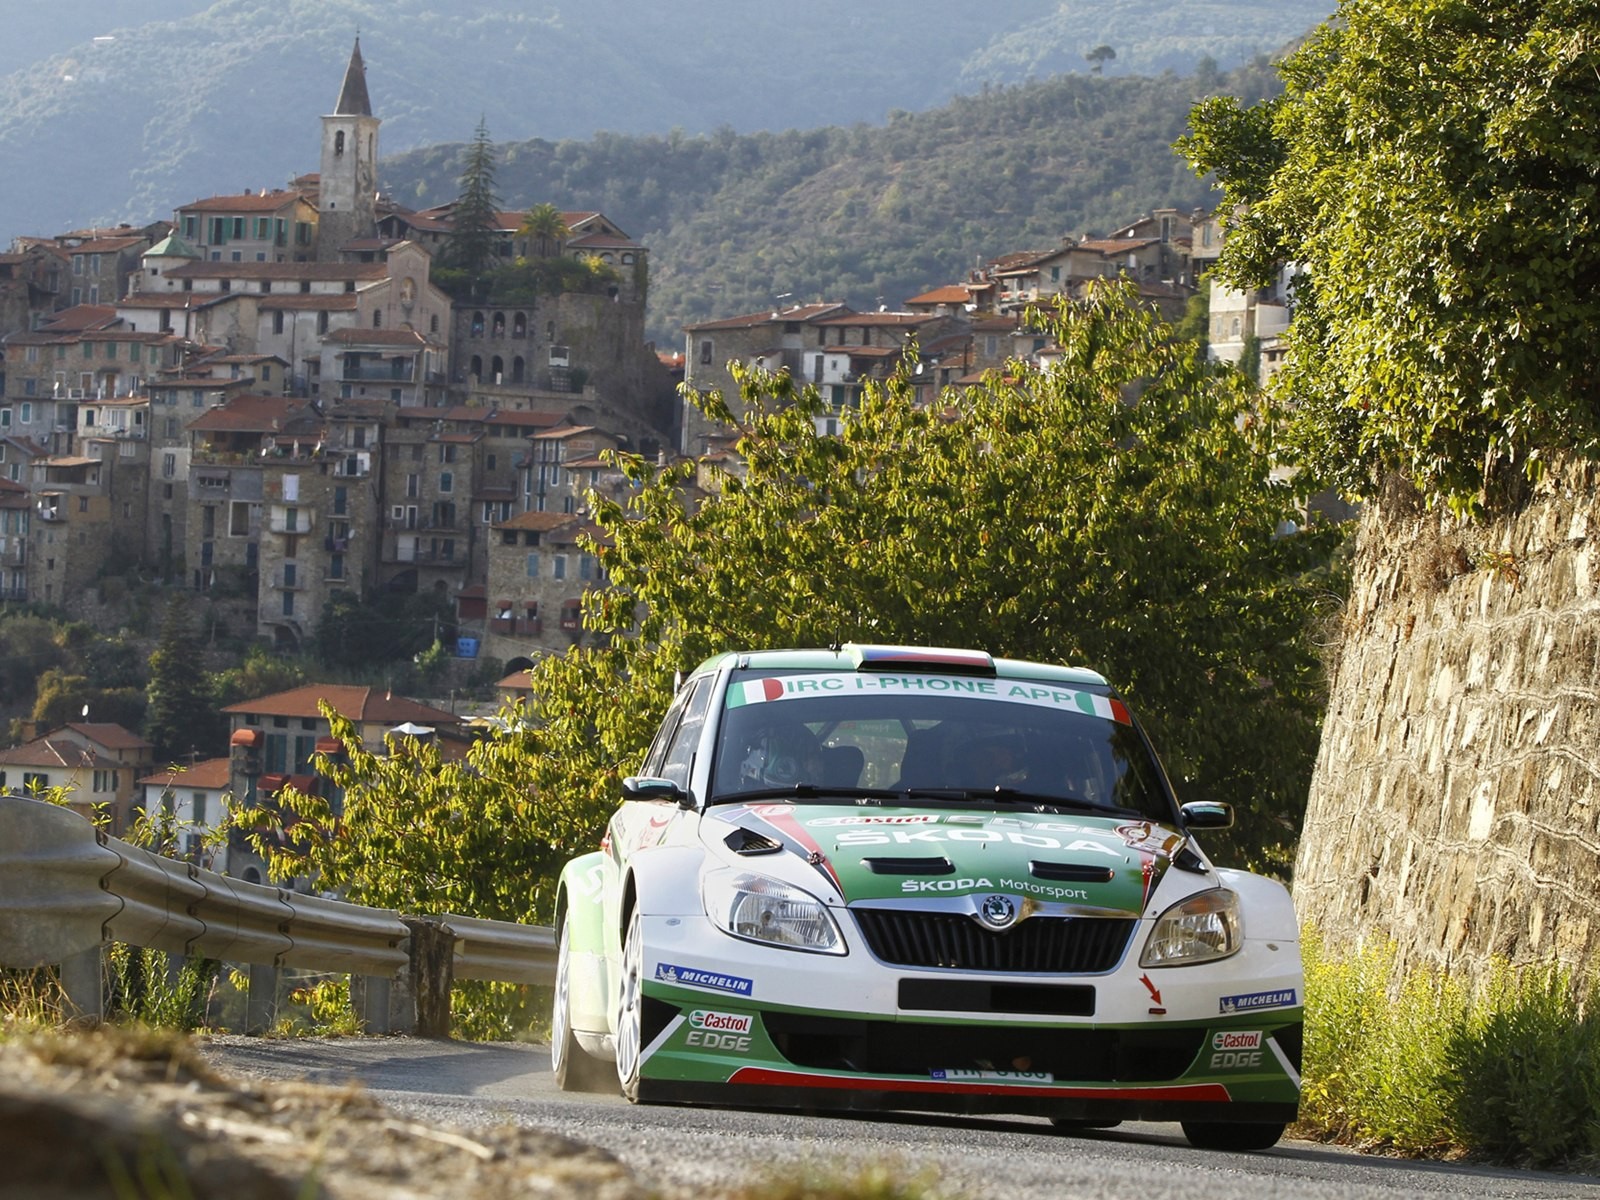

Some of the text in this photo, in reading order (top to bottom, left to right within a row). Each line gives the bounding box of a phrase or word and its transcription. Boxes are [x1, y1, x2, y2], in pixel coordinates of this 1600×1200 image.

[787, 677, 1072, 703] IRC I-PHONE APP
[839, 815, 931, 824] Castrol
[835, 829, 1122, 857] ŠKODA
[902, 878, 1088, 900] ŠKODA Motorsport
[680, 970, 748, 991] MICHELIN
[1237, 992, 1292, 1007] MICHELIN
[704, 1013, 749, 1032] Castrol
[686, 1031, 752, 1052] EDGE
[1223, 1033, 1259, 1048] Castrol
[1209, 1051, 1264, 1069] EDGE
[932, 1070, 945, 1078] CZ
